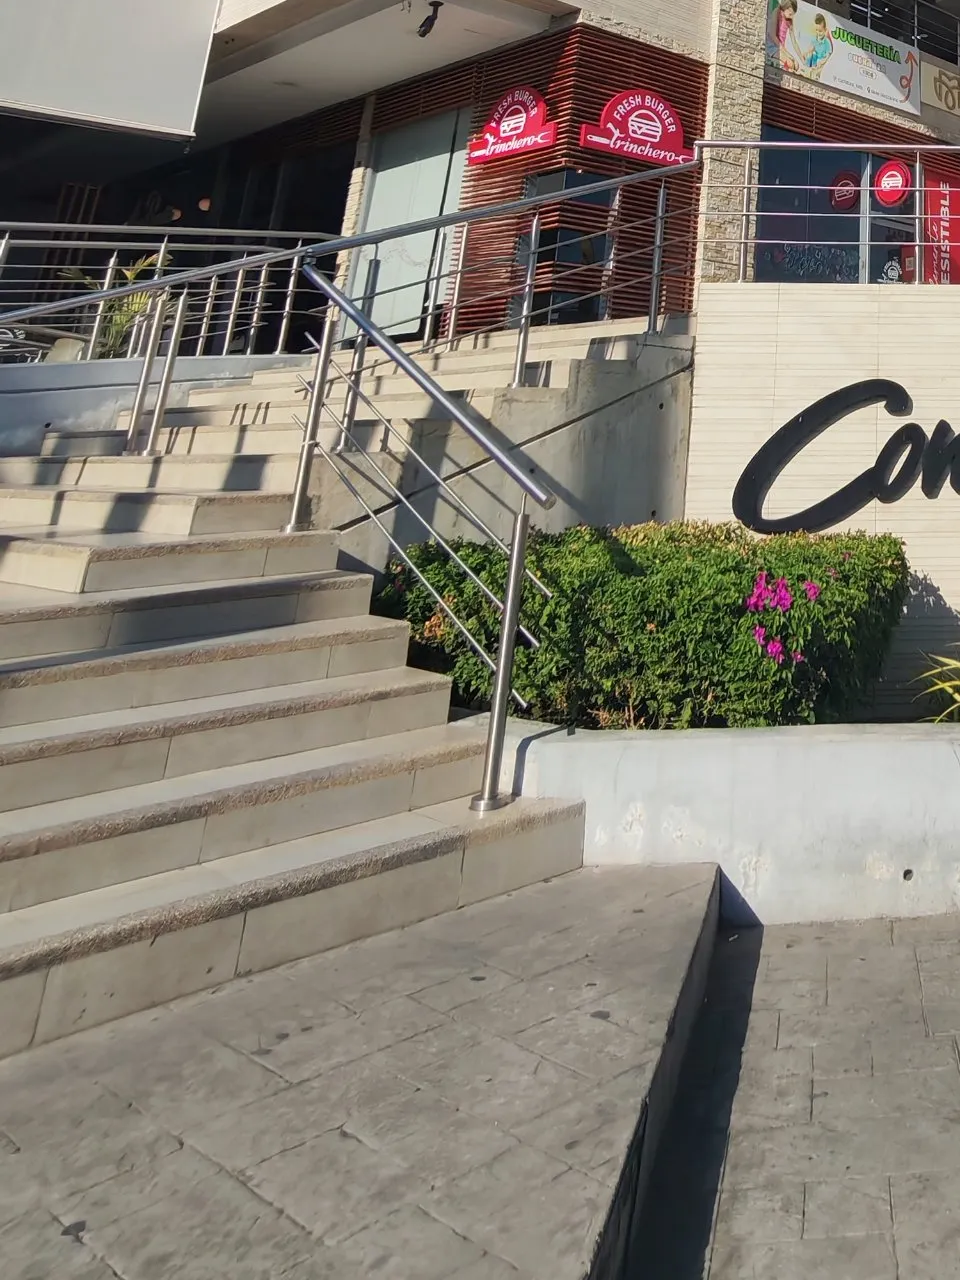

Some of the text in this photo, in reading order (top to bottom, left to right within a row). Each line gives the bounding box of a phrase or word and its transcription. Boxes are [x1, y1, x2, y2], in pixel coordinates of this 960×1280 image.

[832, 26, 901, 65] JUGUETERÍA
[490, 90, 538, 127] FRESH BURGER
[613, 94, 677, 133] FRESH BURGER
